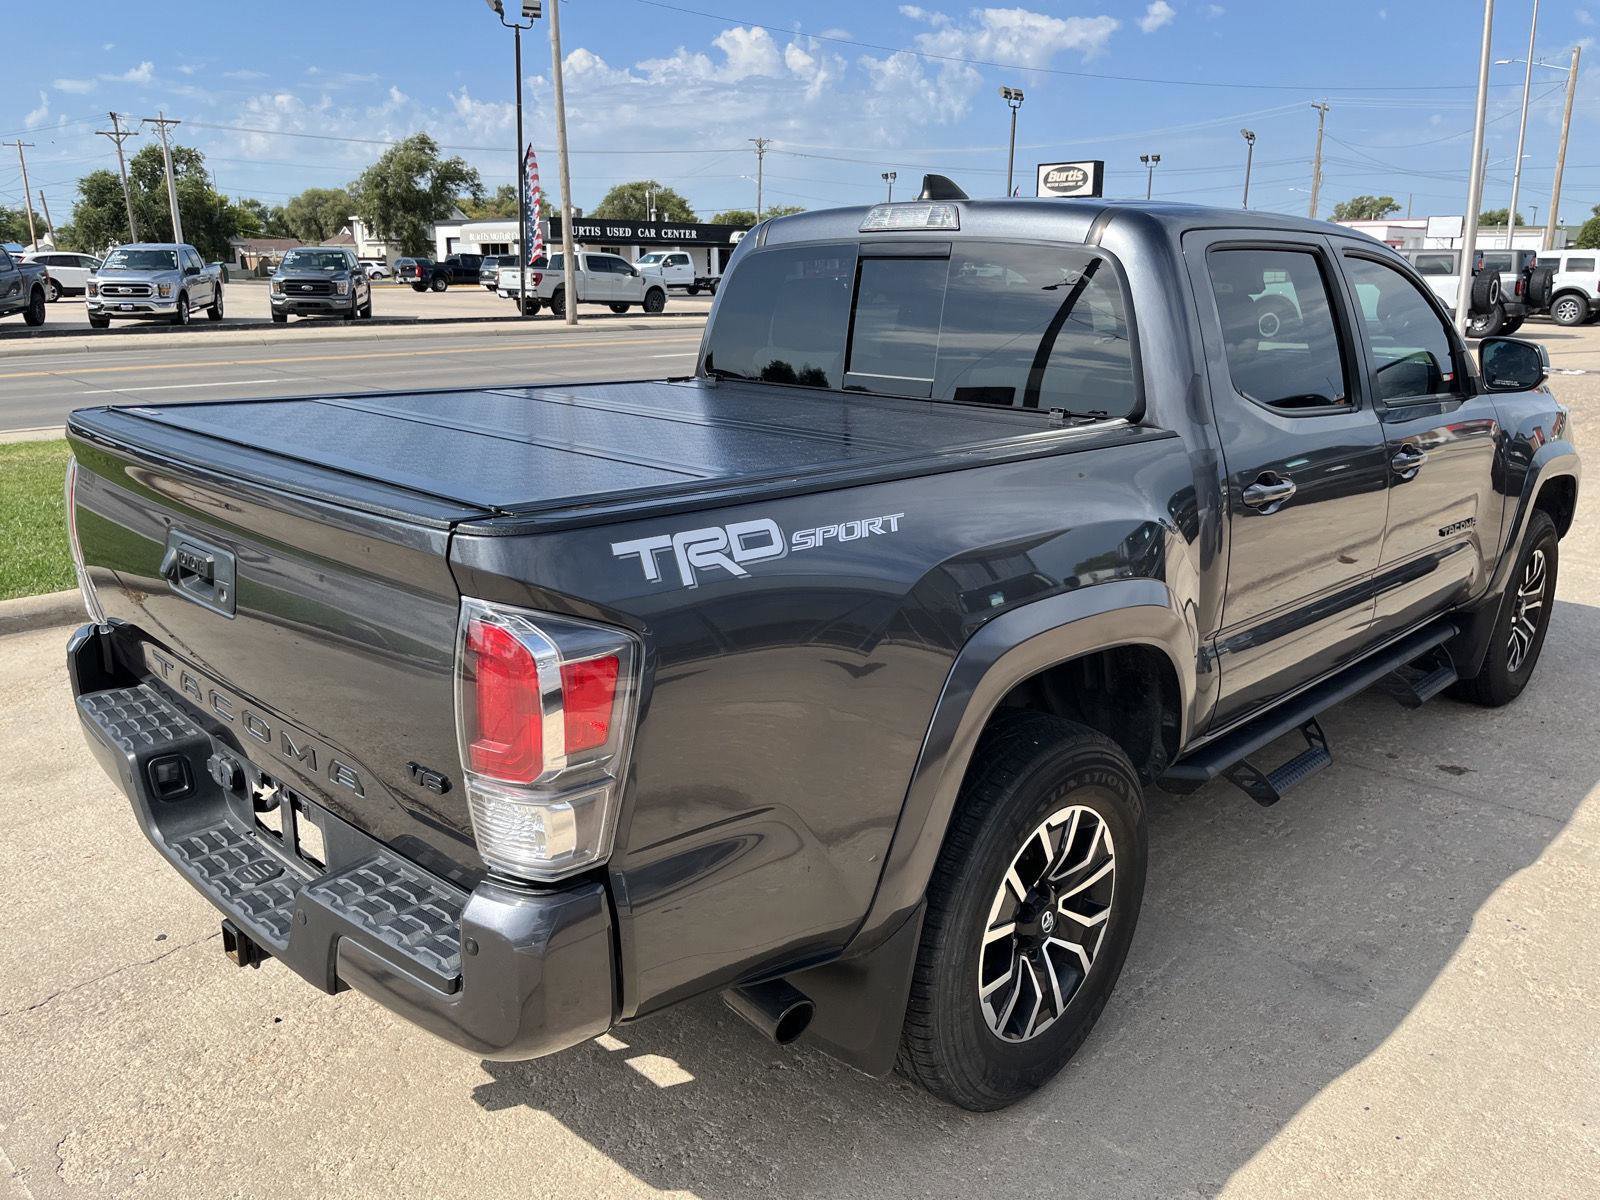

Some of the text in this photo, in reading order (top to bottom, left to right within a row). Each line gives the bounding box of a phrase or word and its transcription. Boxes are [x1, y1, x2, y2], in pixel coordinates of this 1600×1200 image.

[571, 226, 697, 239] URTIS USED CAR CENTER
[610, 512, 905, 589] TRD SPORT
[152, 649, 366, 799] TACOMA
